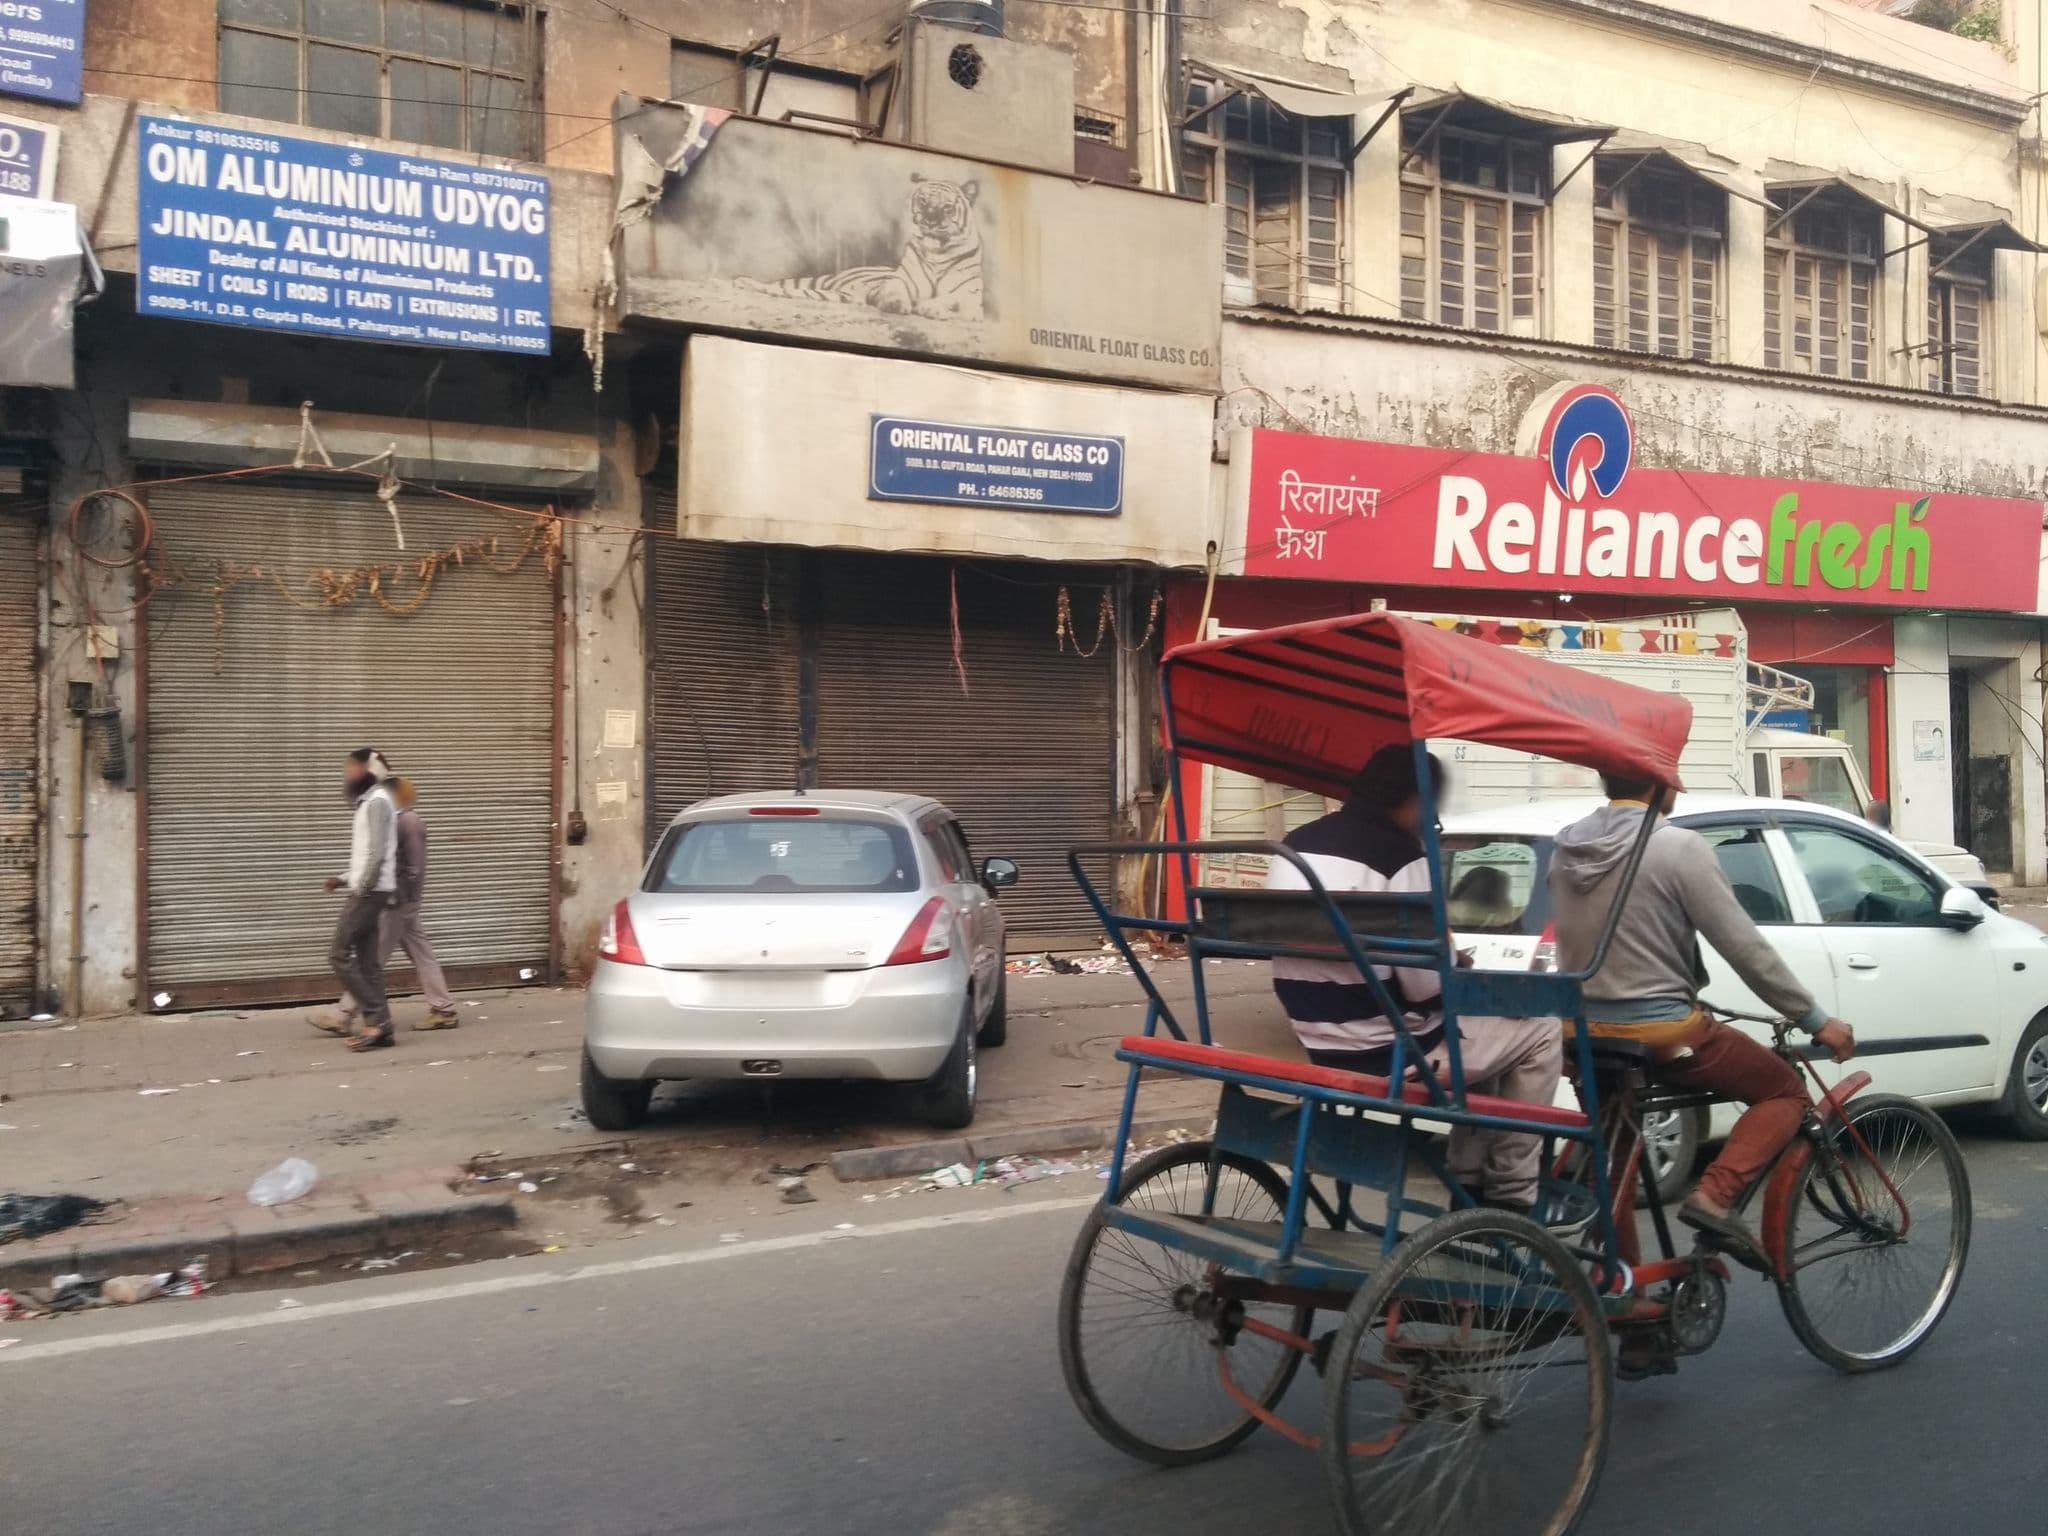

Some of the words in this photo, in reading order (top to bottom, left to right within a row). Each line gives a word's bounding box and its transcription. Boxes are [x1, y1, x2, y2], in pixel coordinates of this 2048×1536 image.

[0, 2, 42, 20] ers
[0, 57, 32, 69] oad
[147, 122, 193, 139] Ankur
[148, 142, 207, 187] OM
[216, 153, 422, 218] ALUMINIUM
[432, 184, 545, 235] UDYOG
[440, 167, 470, 183] Ram
[273, 206, 346, 227] Authorised
[349, 215, 411, 237] Stockists
[413, 226, 428, 237] of
[151, 208, 276, 249] JINDAL
[284, 226, 470, 274] ALUMINIUM
[479, 251, 542, 283] LTD.
[208, 249, 258, 269] Dealer
[259, 257, 276, 271] of
[278, 259, 298, 274] All
[301, 260, 341, 280] Kinds
[343, 267, 359, 282] of
[362, 269, 433, 291] Aluminium
[435, 278, 494, 298] Products
[148, 265, 202, 287] SHEET
[220, 274, 268, 296] COILS
[286, 282, 328, 302] RODS
[346, 290, 392, 310] FLATS
[409, 297, 498, 322] EXTRUSIONS
[514, 309, 546, 328] ETC.
[252, 307, 299, 323] Gupta
[301, 313, 345, 329] Road,
[427, 327, 459, 340] New
[1030, 328, 1096, 353] ORIENTAL
[1100, 338, 1139, 359] FLOAT
[1143, 344, 1186, 364] GLASS
[1190, 351, 1214, 368] CO.
[890, 428, 973, 454] ORIENTAL
[977, 436, 1029, 459] FLOAT
[1032, 441, 1083, 463] GLASS
[1087, 447, 1109, 465] CO
[941, 460, 965, 472] GUPTA
[988, 465, 1011, 476] PAHAR
[1033, 468, 1049, 479] NEW
[958, 483, 979, 496] PH.
[1278, 469, 1381, 518] रिलायंस
[1275, 514, 1327, 560] फ्रेश
